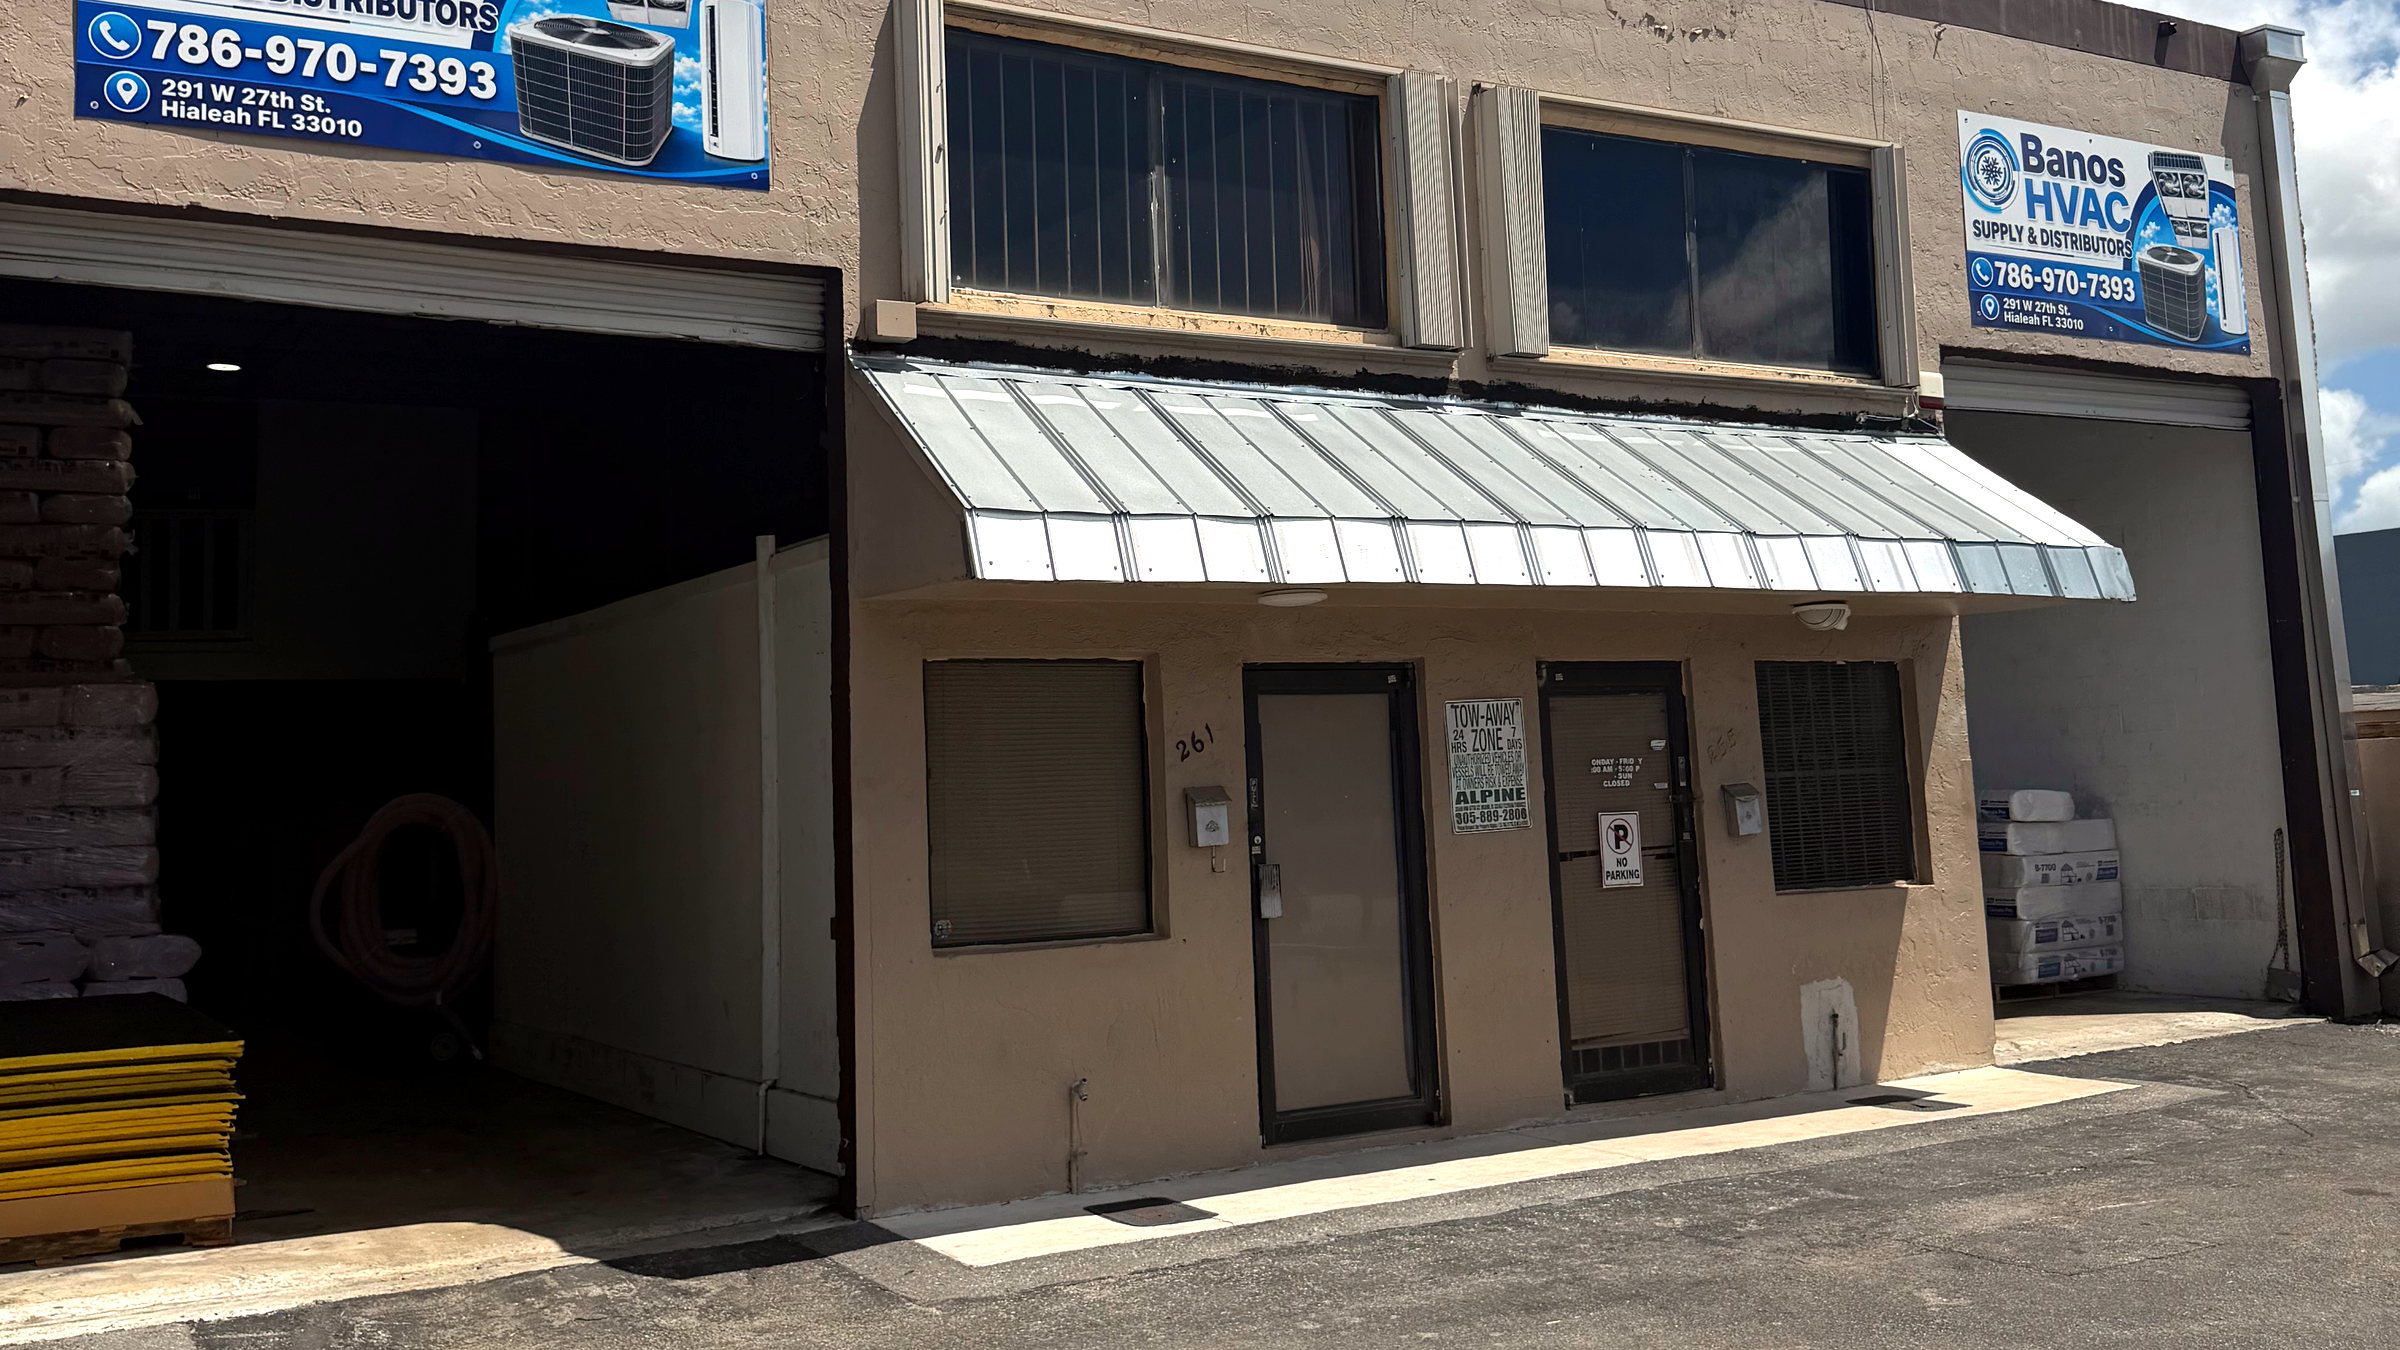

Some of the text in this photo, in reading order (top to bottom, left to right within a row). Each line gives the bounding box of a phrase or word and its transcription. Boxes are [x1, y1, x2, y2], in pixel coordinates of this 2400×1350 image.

[271, 0, 499, 31] RIBUTORS
[147, 19, 498, 99] 786-970-7393
[161, 78, 331, 114] 291 W 27th St.
[161, 99, 363, 138] Hialeah FL 33010
[2020, 132, 2126, 187] Banos
[2024, 178, 2132, 233] HVAC
[1972, 219, 2133, 259] SUPPLY & DISTRIBUTORS
[1993, 261, 2136, 302] 786-970-7393
[2003, 297, 2071, 316] 291 W 27th St.
[2004, 310, 2084, 331] Hialeah FL 33010
[1451, 702, 1515, 728] TOW-AWAY
[1175, 722, 1214, 762] 261
[1451, 738, 1522, 753] HRS DAYS
[1453, 726, 1516, 752] 24 ZONE 7
[1591, 758, 1614, 766] ONDAY
[1455, 787, 1526, 805] ALPINE
[1606, 869, 1640, 880] PARKING
[1616, 857, 1628, 867] NO
